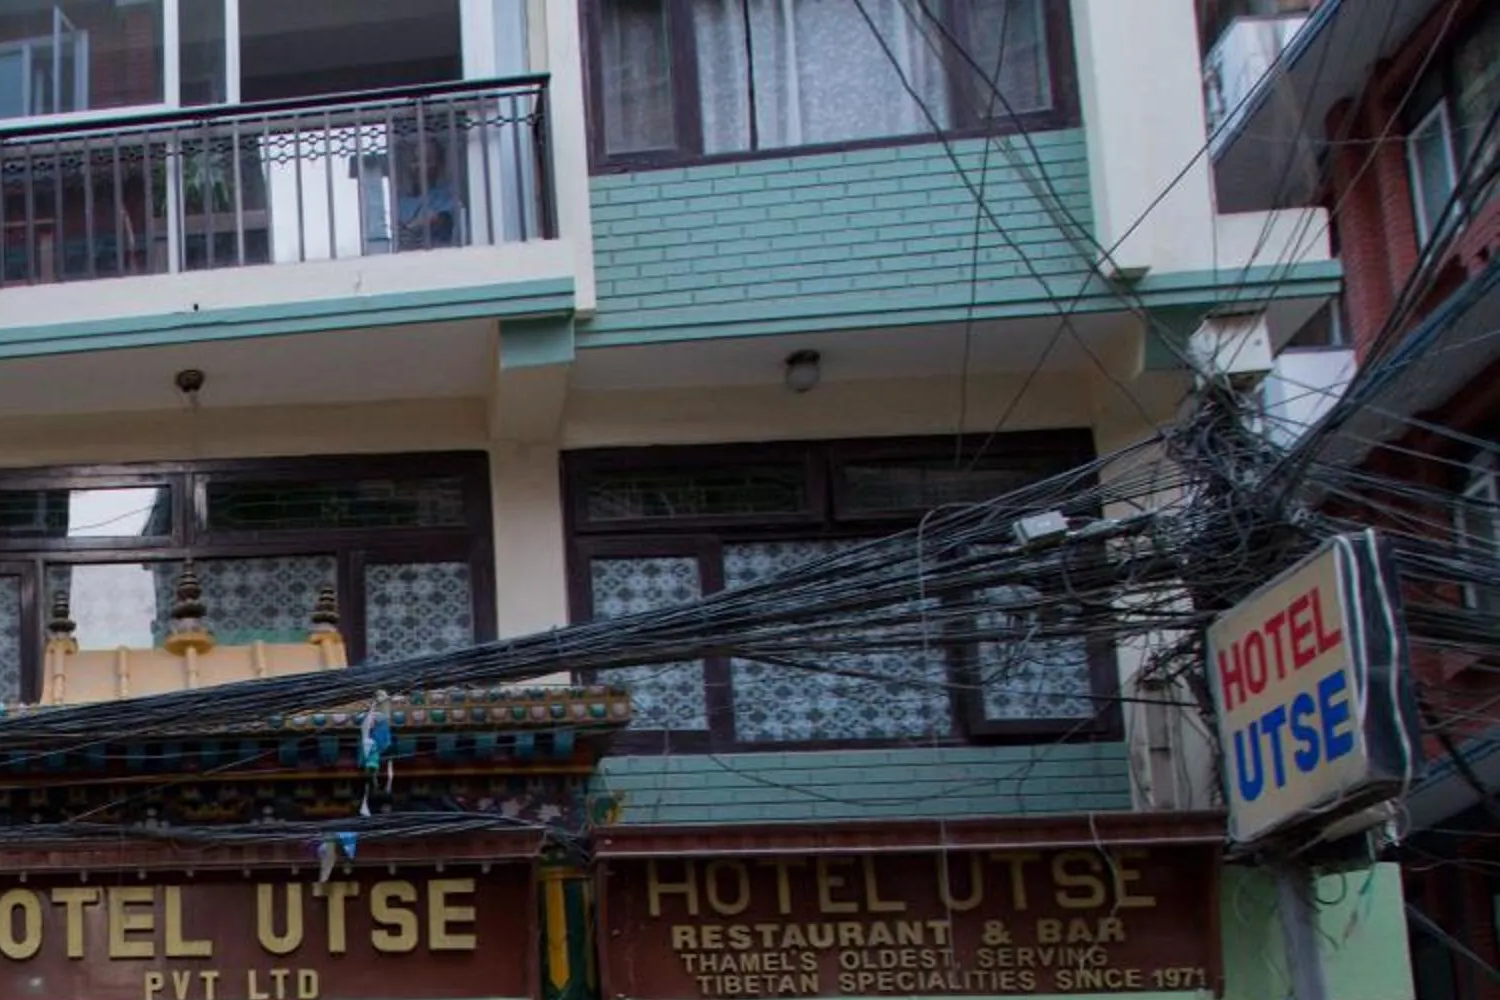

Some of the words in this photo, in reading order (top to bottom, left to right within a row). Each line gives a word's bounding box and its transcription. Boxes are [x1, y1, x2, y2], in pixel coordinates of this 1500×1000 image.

[1217, 586, 1343, 713] HOTEL
[1233, 669, 1355, 802] UTSE
[646, 855, 907, 918] HOTEL
[940, 848, 1157, 912] UTSE
[256, 878, 477, 955] UTSE
[672, 920, 952, 950] RESTAURANT
[982, 920, 1012, 944] &
[1036, 917, 1126, 943] BAR
[248, 968, 320, 1000] LTD
[681, 949, 818, 973] THAMEL'S
[976, 945, 1108, 968] SERVING
[697, 972, 820, 996] TIBETAN
[837, 968, 1036, 992] SPECIALITIES
[1054, 966, 1142, 989] SINCE
